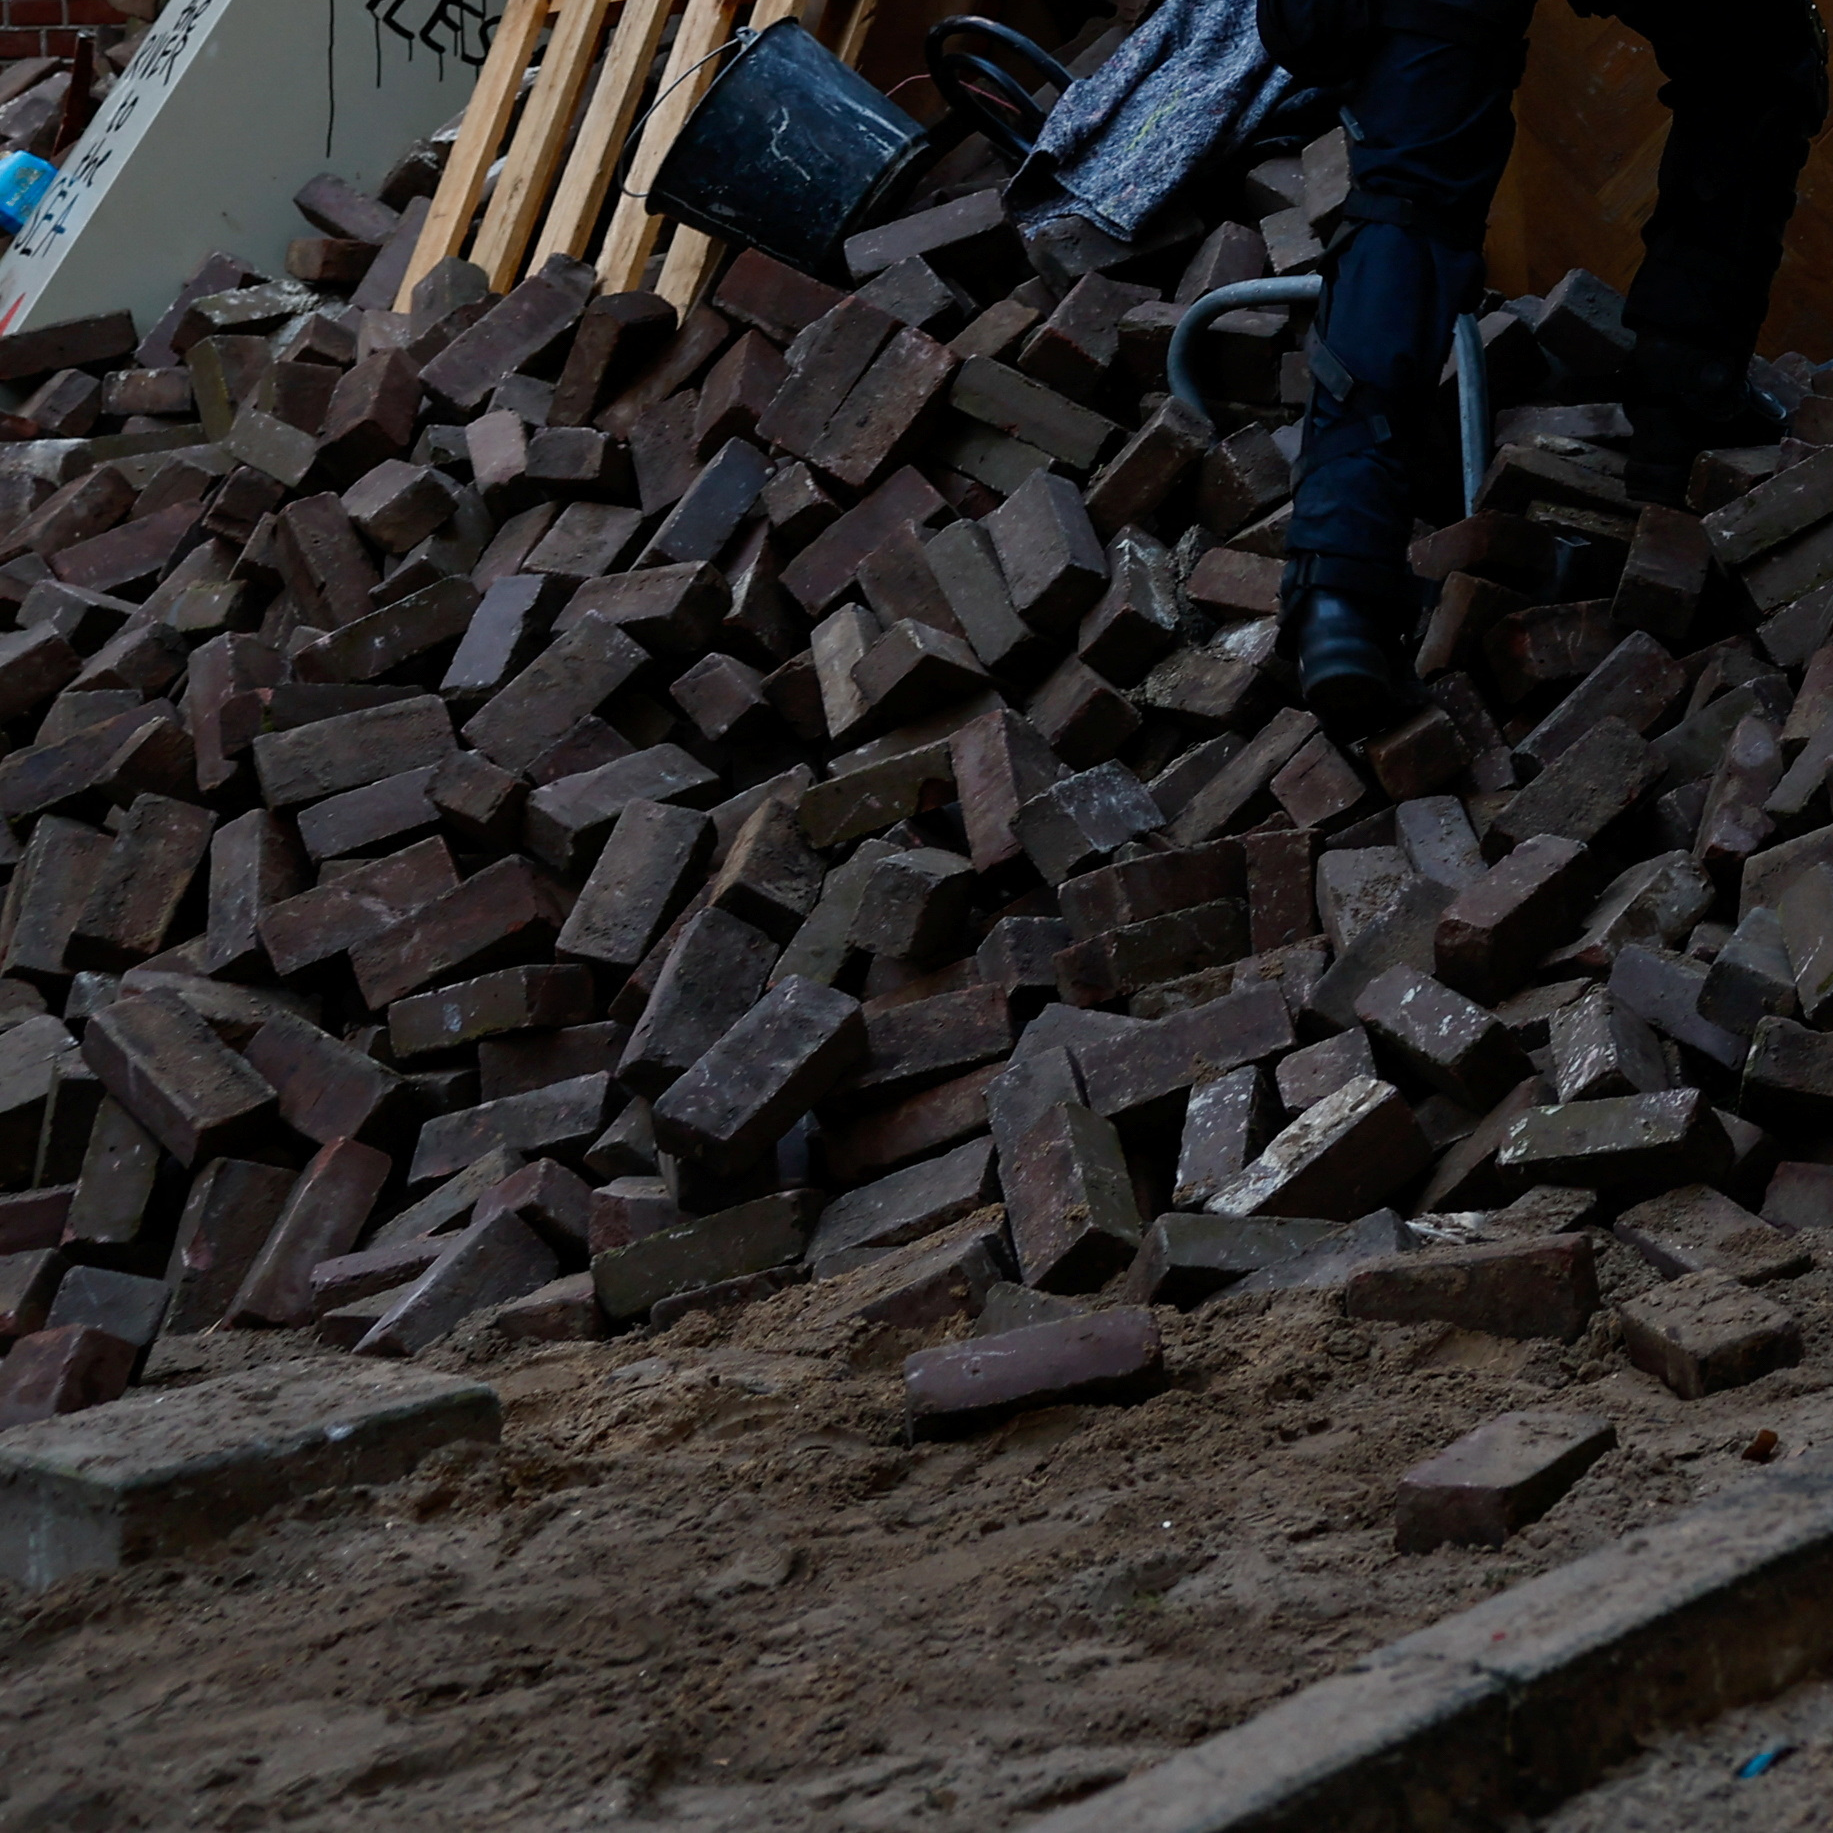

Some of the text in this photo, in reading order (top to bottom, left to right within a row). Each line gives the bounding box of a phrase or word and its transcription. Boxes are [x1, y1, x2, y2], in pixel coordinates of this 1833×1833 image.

[123, 32, 190, 87] RIVER
[106, 91, 139, 133] to
[67, 138, 112, 188] the
[12, 175, 80, 258] SEA
